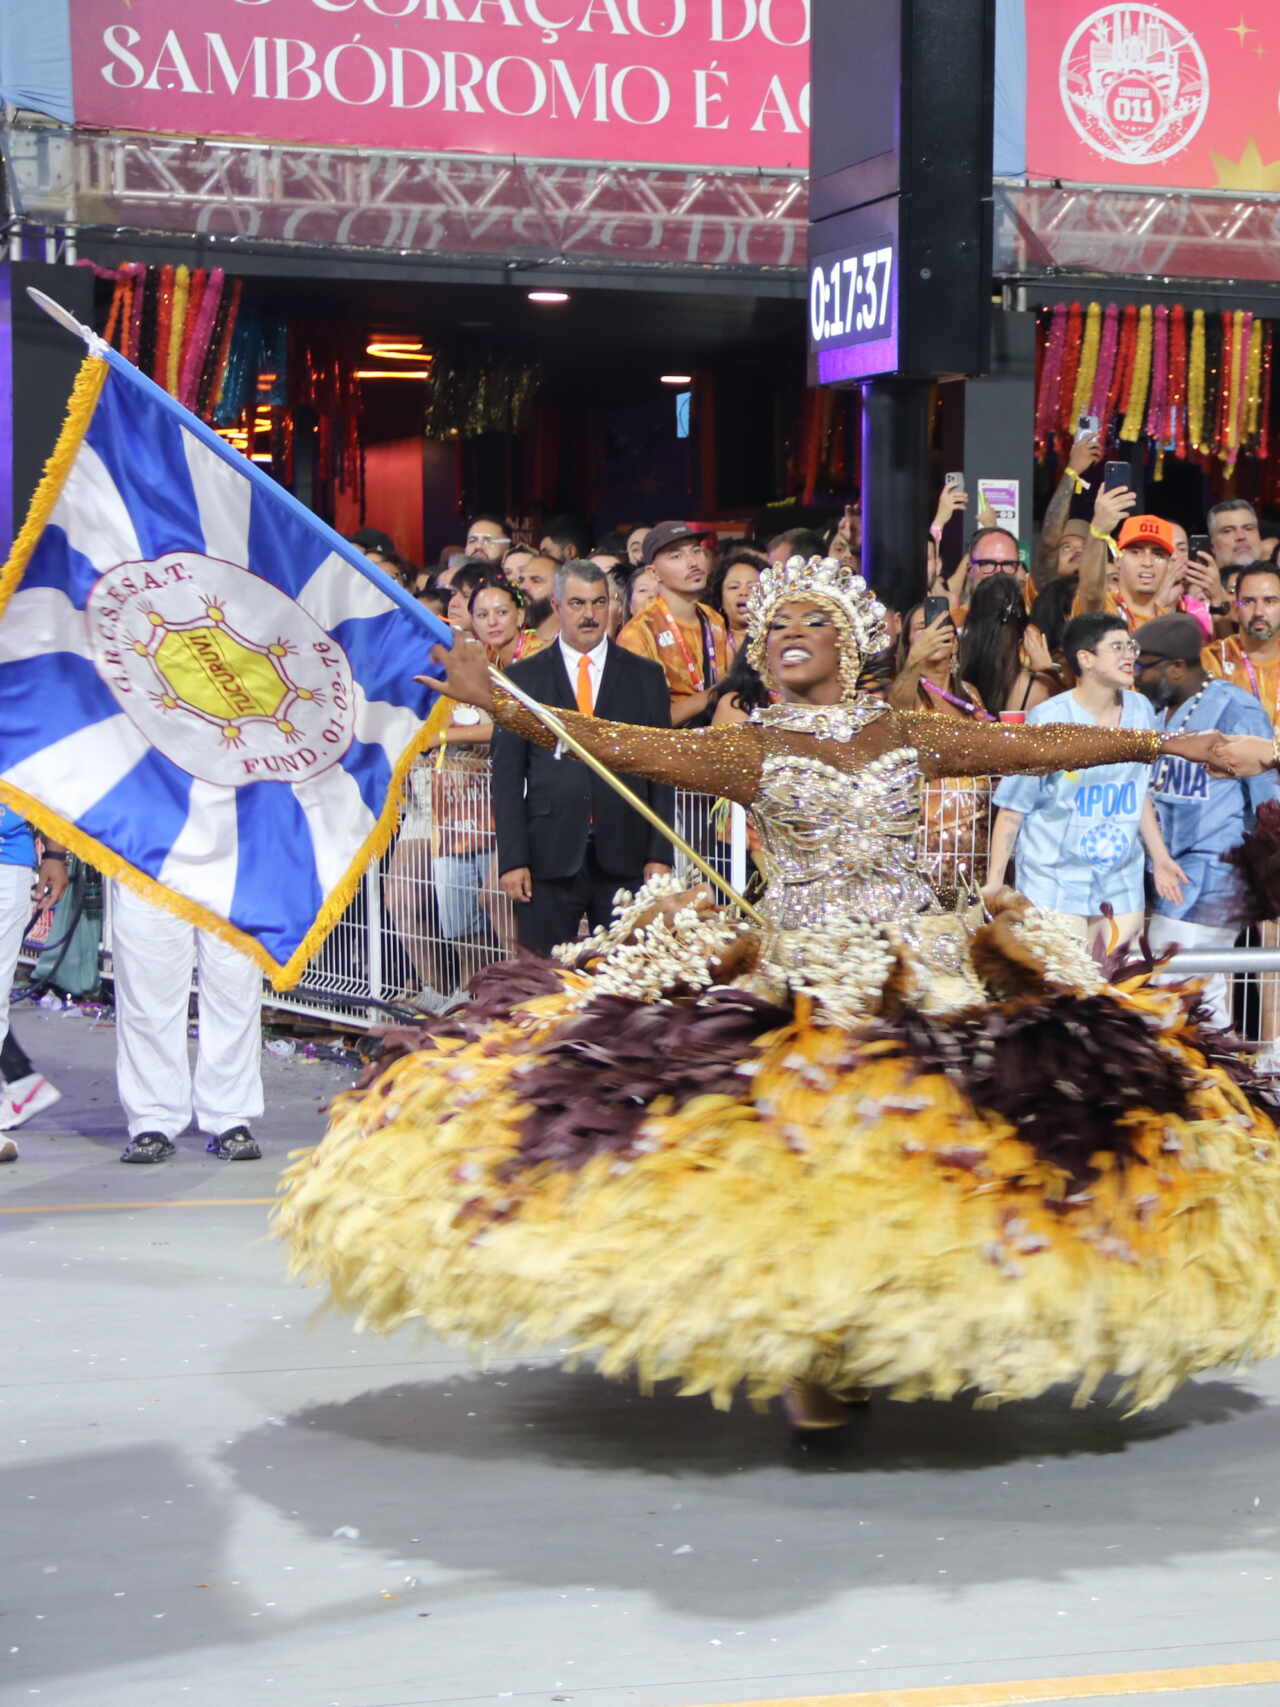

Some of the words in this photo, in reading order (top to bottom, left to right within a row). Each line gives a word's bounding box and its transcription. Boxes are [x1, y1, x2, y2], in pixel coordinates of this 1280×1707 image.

[100, 24, 670, 125] SAMBÓDROMO
[692, 60, 730, 130] É
[750, 74, 811, 134] A
[1113, 97, 1155, 123] 011
[811, 246, 893, 342] 0:17:37
[189, 633, 257, 714] TUCURUVI
[241, 746, 329, 774] FUND.
[1073, 781, 1137, 817] APOIO
